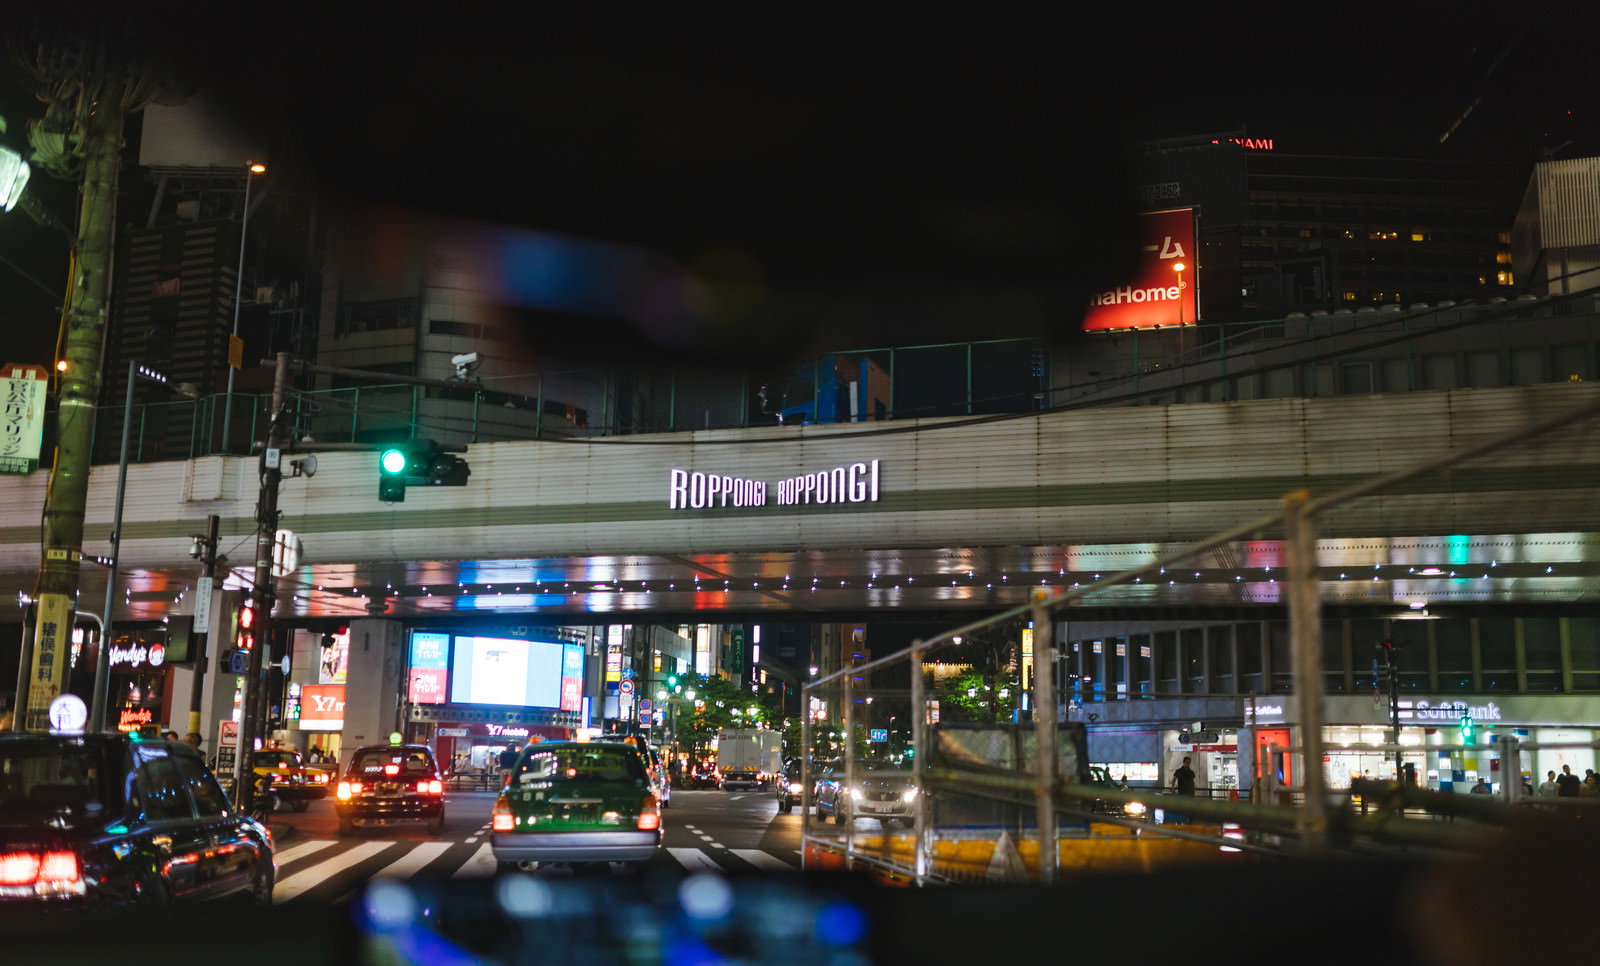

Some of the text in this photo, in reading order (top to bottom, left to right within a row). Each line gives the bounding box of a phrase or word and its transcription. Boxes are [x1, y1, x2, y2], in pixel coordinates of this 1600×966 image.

[670, 459, 879, 509] ROPPONGI ROPPONGI
[1416, 699, 1502, 720] SoftBank
